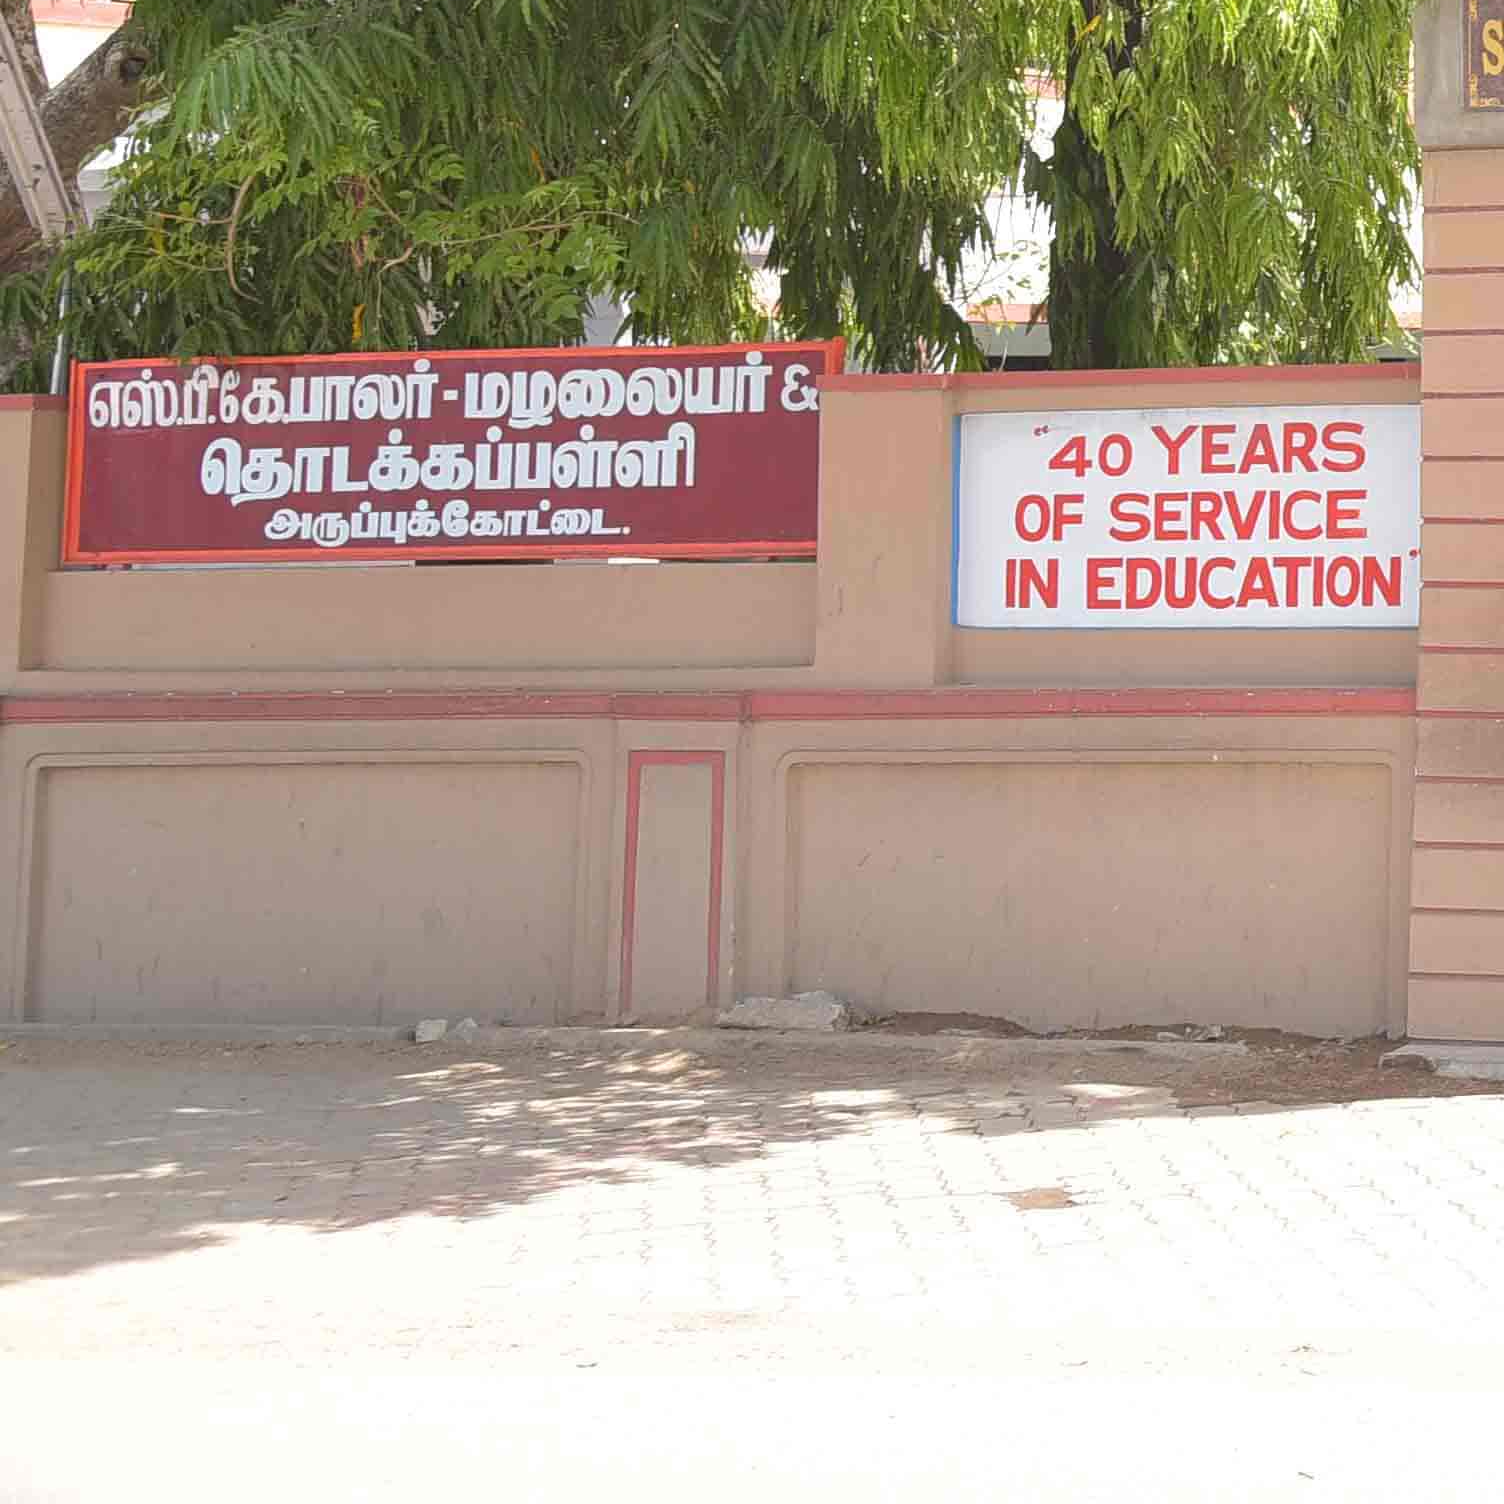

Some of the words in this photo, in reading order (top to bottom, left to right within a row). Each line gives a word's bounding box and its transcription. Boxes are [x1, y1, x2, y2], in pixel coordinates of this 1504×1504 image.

[200, 421, 696, 507] தொடக்கப்பள்ளி
[1151, 421, 1367, 476] YEARS
[1014, 493, 1086, 542] OF
[1109, 488, 1369, 543] SERVICE
[1005, 558, 1060, 610] IN
